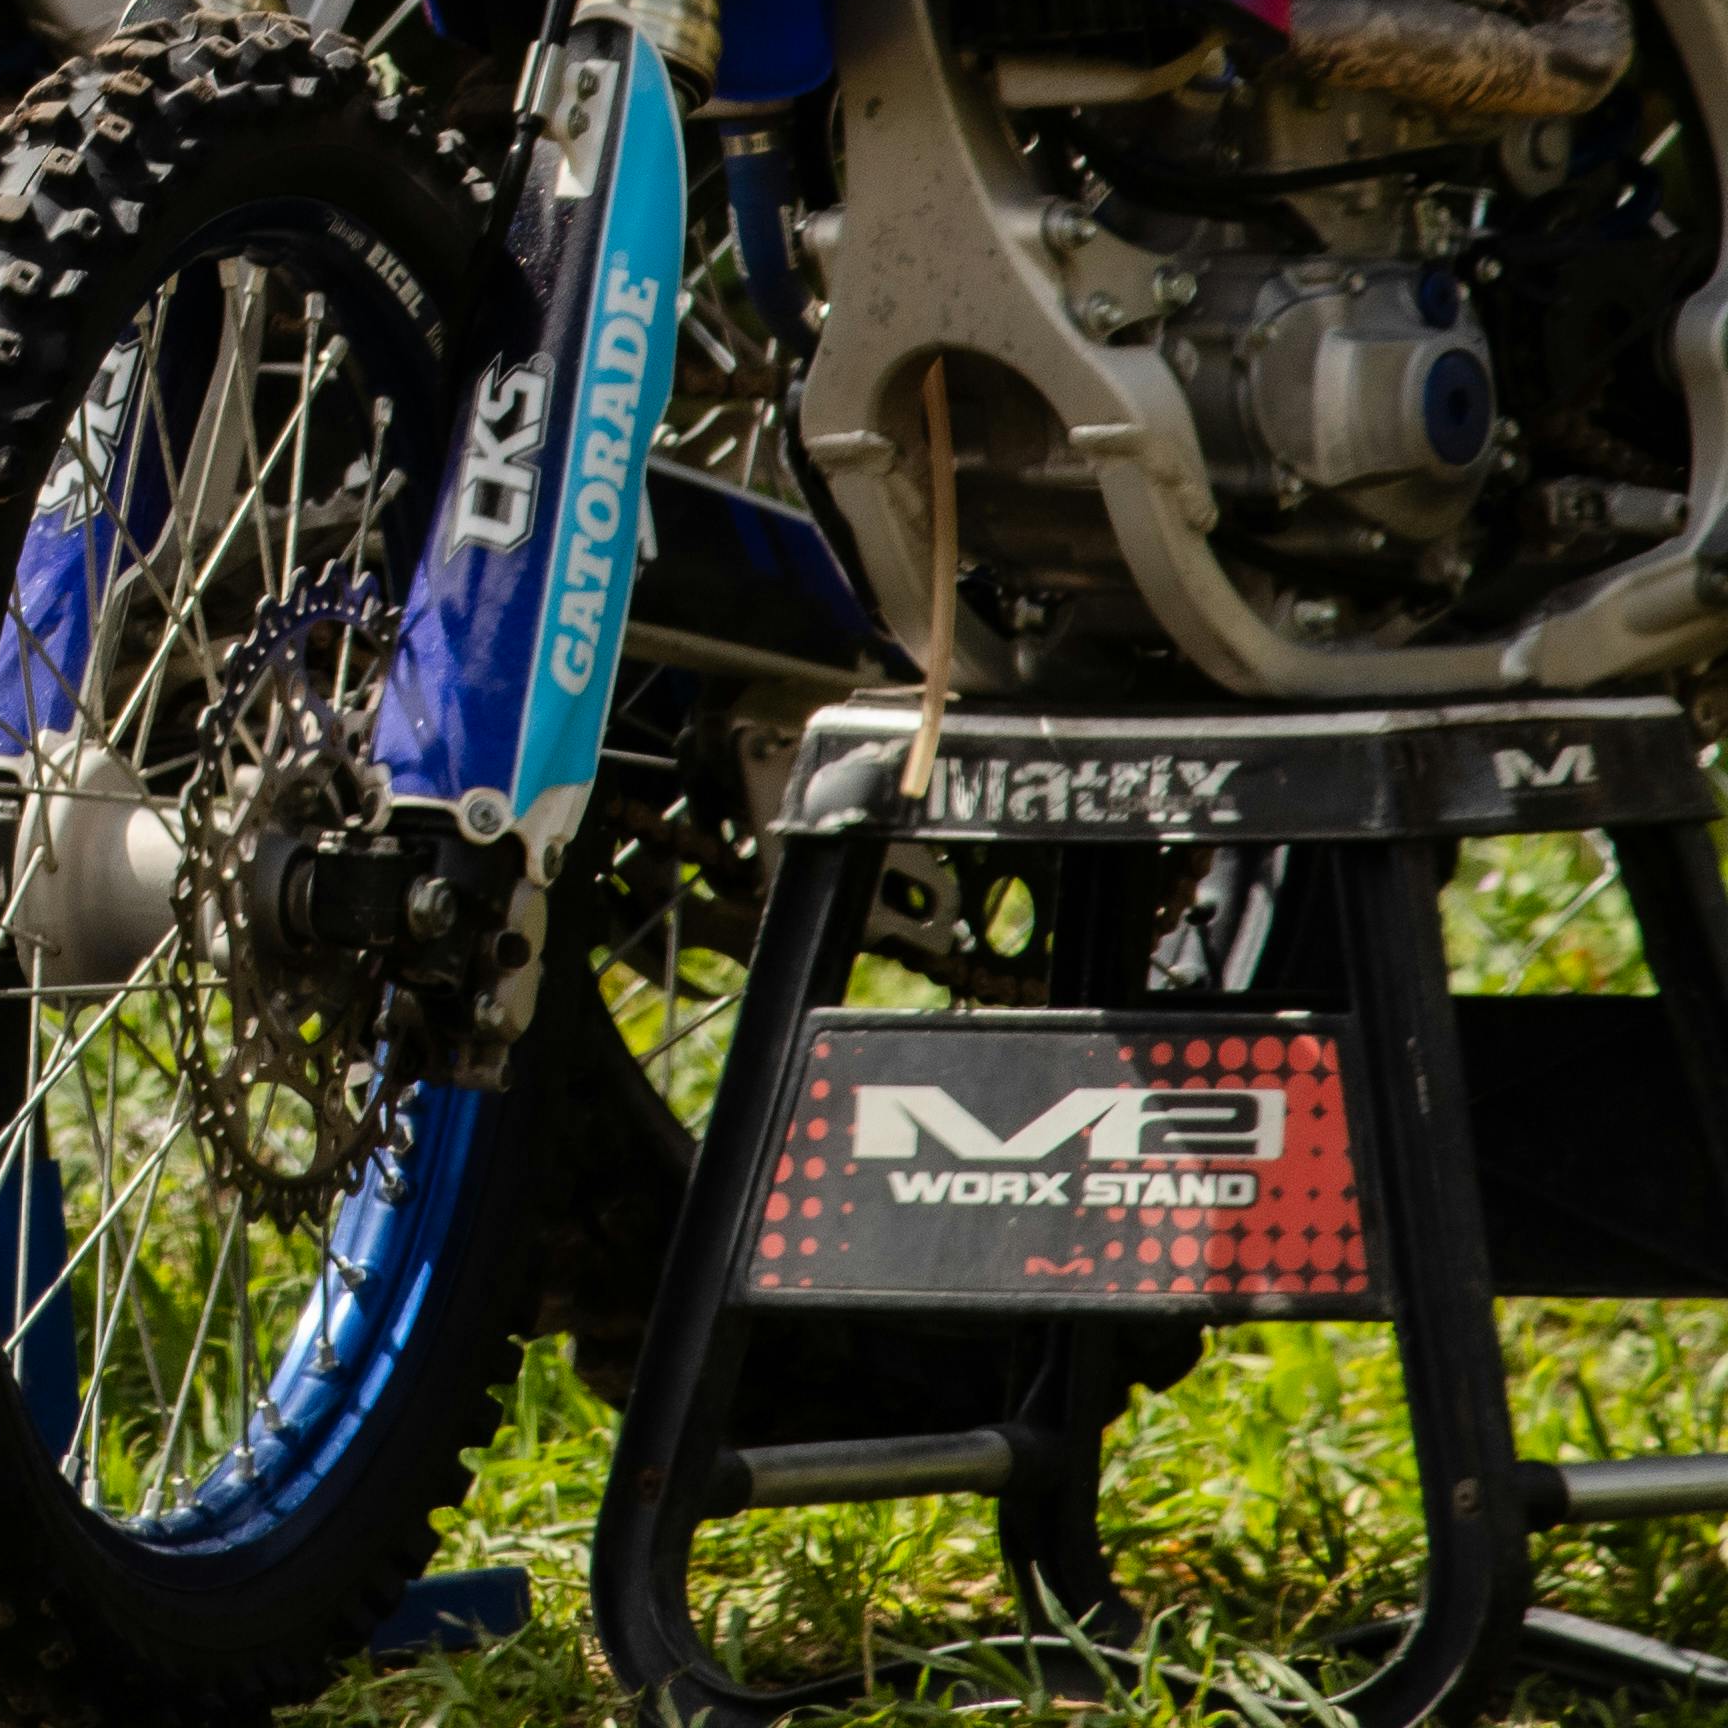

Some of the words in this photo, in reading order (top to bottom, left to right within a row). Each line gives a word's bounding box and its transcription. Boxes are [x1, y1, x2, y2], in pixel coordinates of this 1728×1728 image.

[450, 365, 546, 553] CKS
[551, 274, 659, 697] GATORADE
[927, 756, 1242, 822] Matrix
[853, 1085, 1287, 1162] M2
[889, 1171, 1071, 1208] WORX
[1083, 1172, 1258, 1209] STAND
